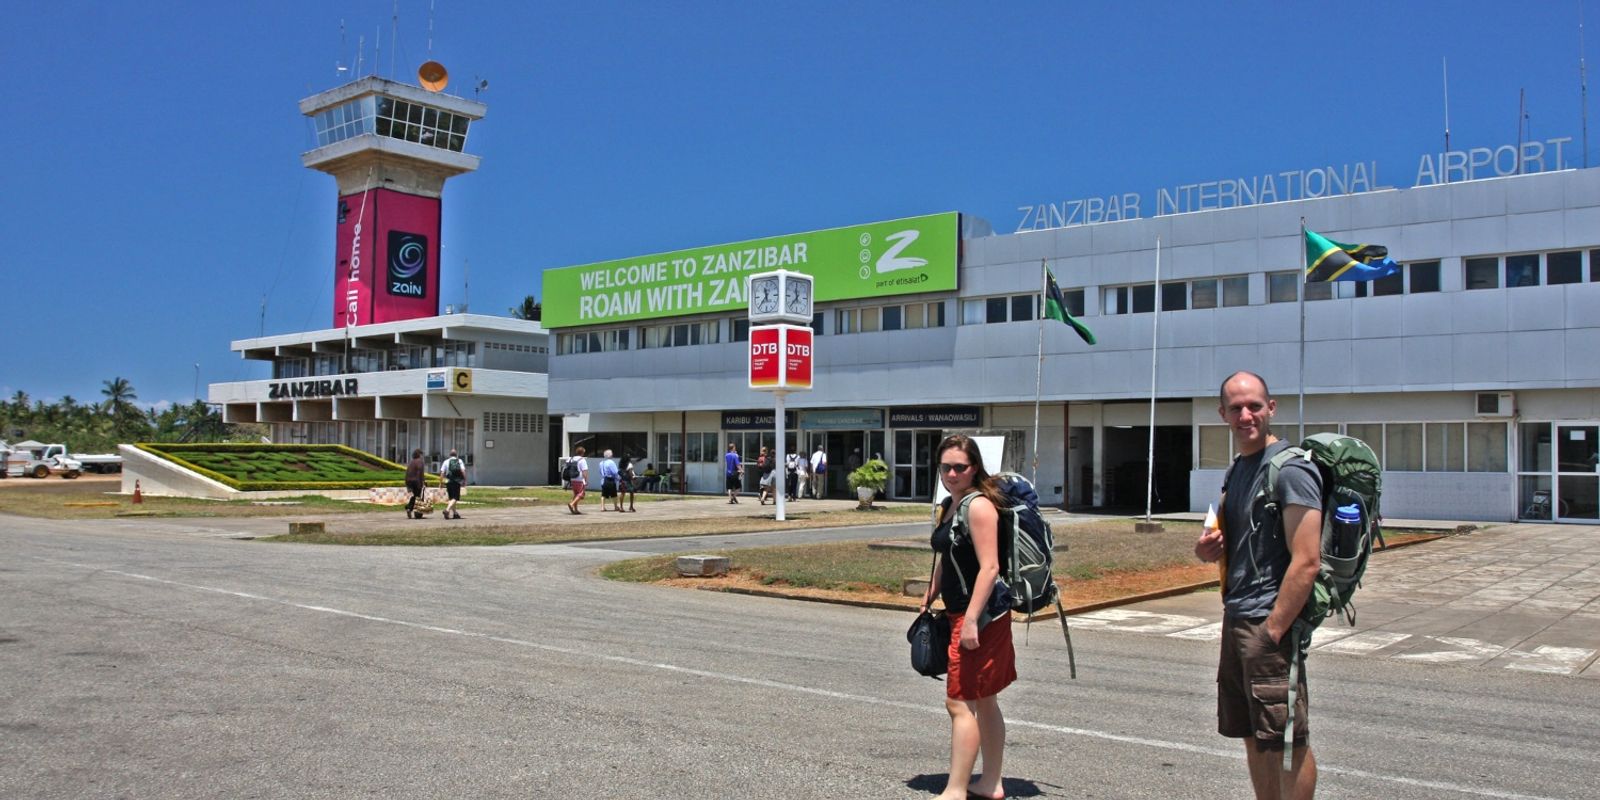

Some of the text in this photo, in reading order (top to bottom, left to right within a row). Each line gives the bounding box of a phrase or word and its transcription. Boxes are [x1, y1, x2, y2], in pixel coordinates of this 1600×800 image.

[1016, 137, 1573, 232] ZANZIBAR INTERNATIONAL AIRPORT
[346, 222, 362, 328] Call home
[580, 242, 808, 291] WELCOME TO ZANZIBAR
[579, 288, 642, 320] ROAM
[646, 282, 703, 315] WITH
[752, 342, 778, 355] DTB
[787, 343, 810, 357] DTB
[268, 377, 359, 399] ZANZIBAR
[456, 371, 469, 389] C
[726, 415, 751, 424] KARIBU
[891, 413, 924, 422] ARRIVALS
[928, 413, 977, 422] WANAOWASILI
